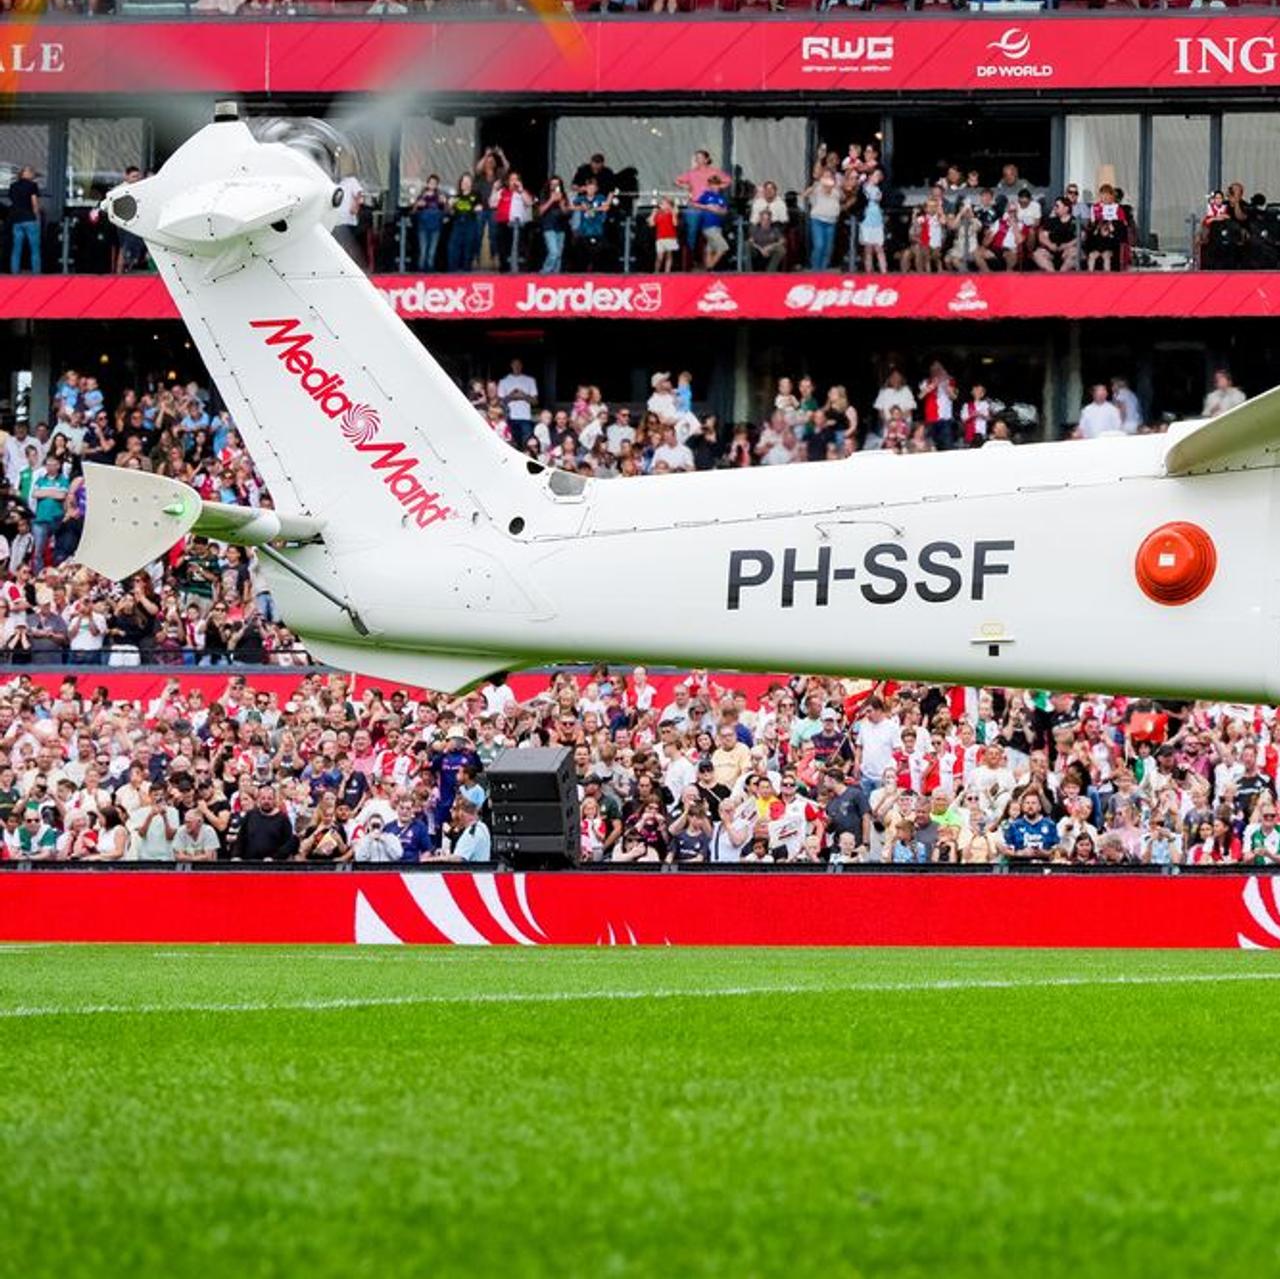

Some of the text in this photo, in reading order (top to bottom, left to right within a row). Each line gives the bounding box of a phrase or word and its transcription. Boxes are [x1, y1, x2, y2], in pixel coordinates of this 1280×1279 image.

[802, 36, 894, 61] RWG
[1174, 36, 1279, 74] ING
[976, 64, 1053, 78] DP WORLD
[377, 282, 466, 313] rdex
[516, 282, 635, 312] Jordex
[784, 279, 898, 311] Spido
[249, 318, 450, 529] Media Markt
[727, 539, 1015, 610] PH-SSF
